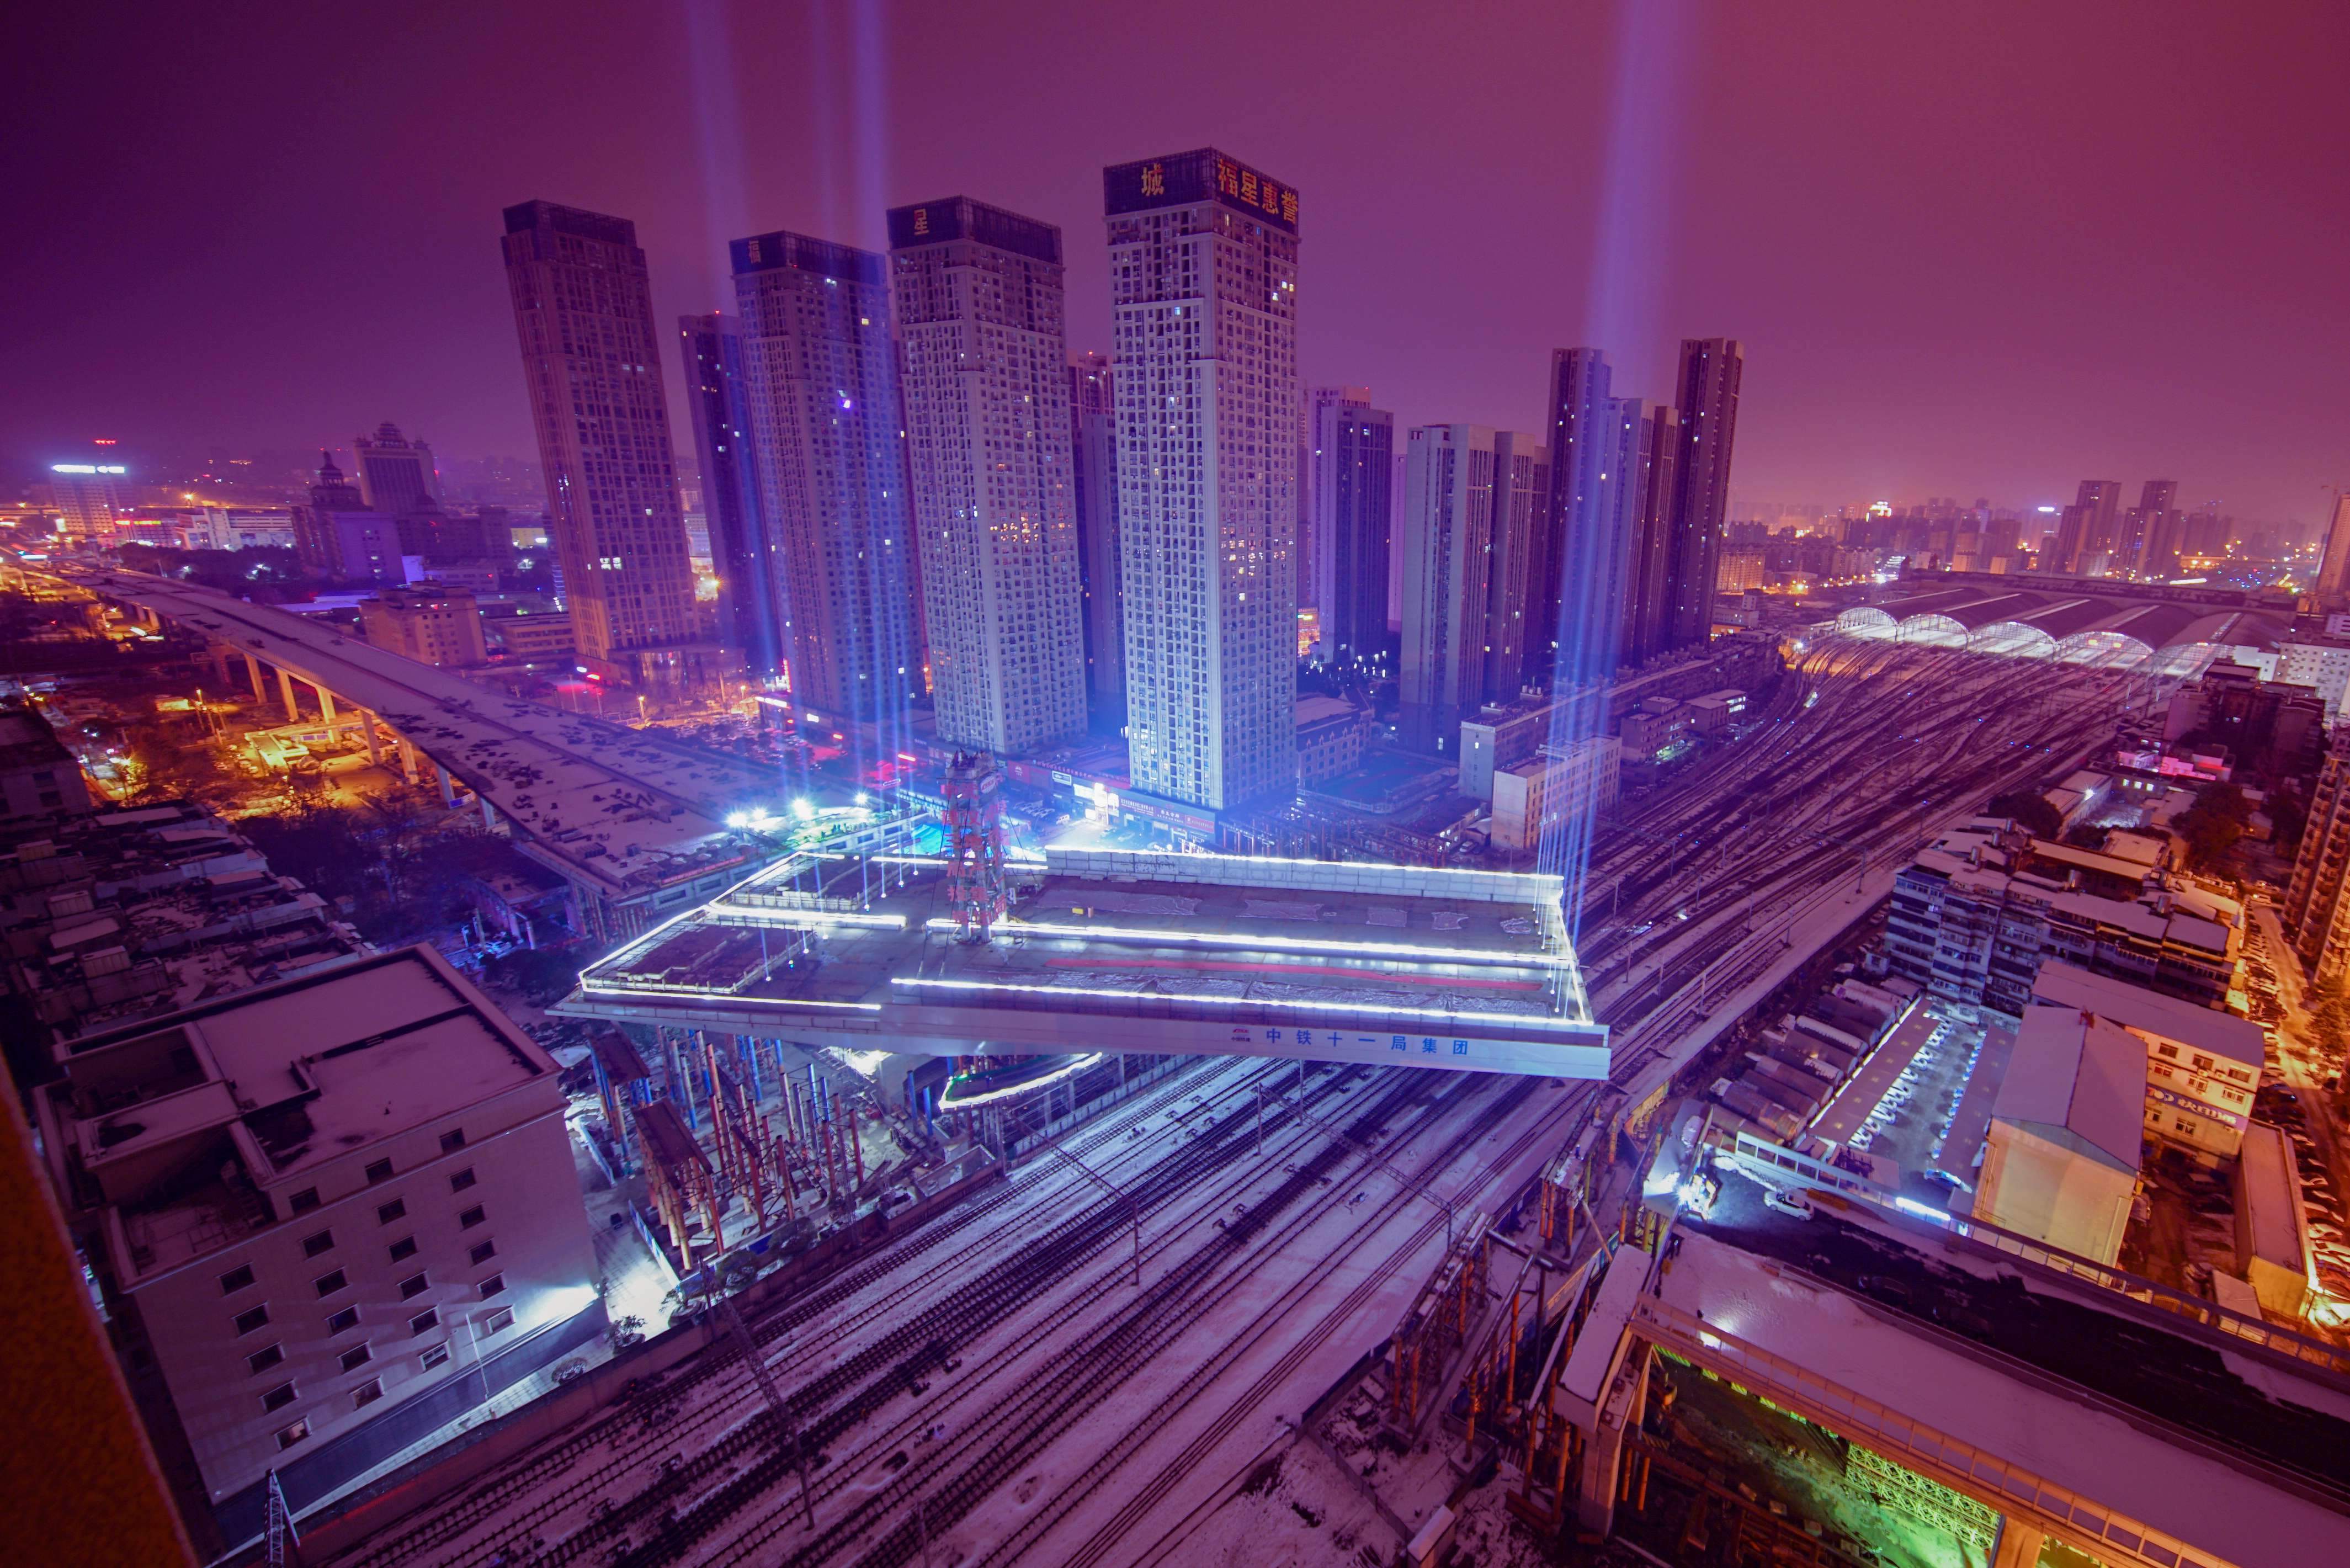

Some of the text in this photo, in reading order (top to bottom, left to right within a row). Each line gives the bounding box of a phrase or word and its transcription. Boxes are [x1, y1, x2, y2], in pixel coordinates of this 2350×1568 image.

[1141, 163, 1165, 196] 城
[1218, 158, 1299, 225] 福星惠誉
[1266, 1028, 1469, 1055] 中铁十一局集团
